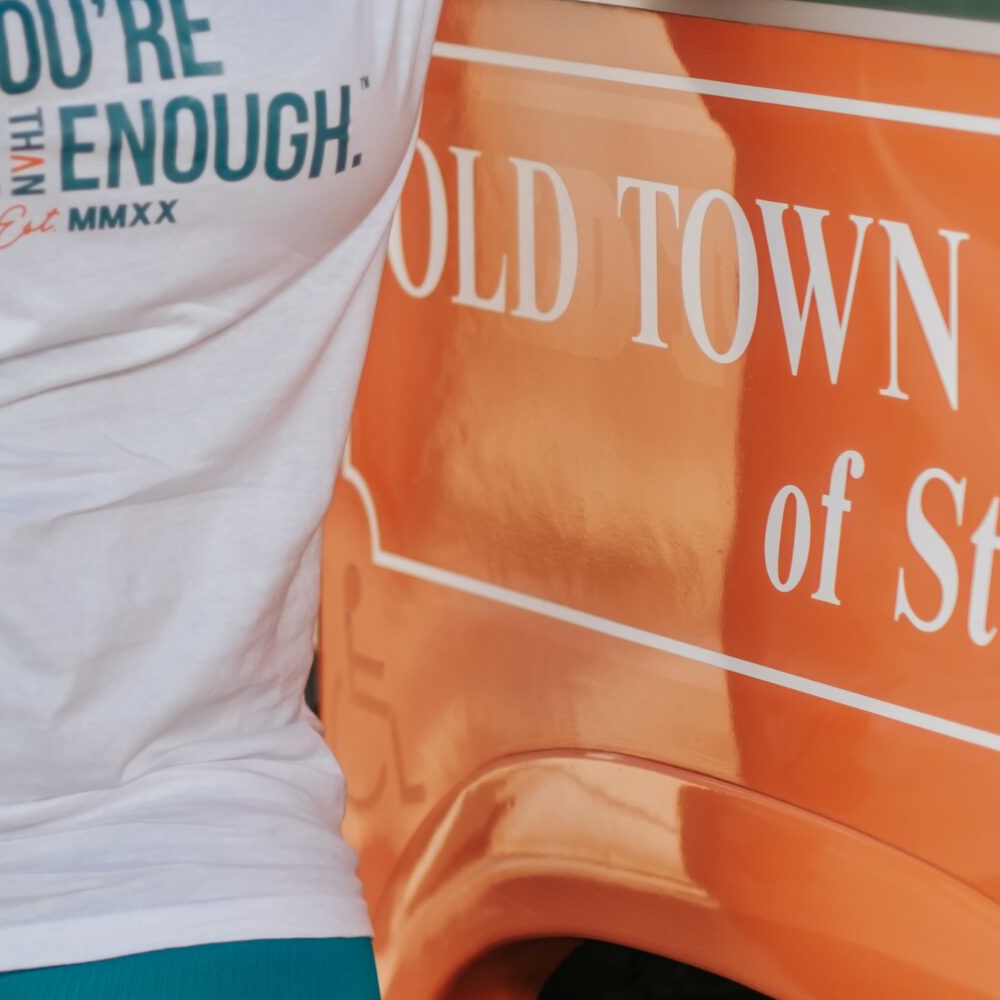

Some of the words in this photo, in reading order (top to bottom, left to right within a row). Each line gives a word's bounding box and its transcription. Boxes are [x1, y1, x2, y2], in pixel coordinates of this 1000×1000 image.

[59, 85, 362, 192] ENOUGH.
[68, 200, 179, 231] MMXX
[388, 138, 579, 323] OLD
[617, 176, 970, 411] TOWN
[764, 450, 865, 606] of
